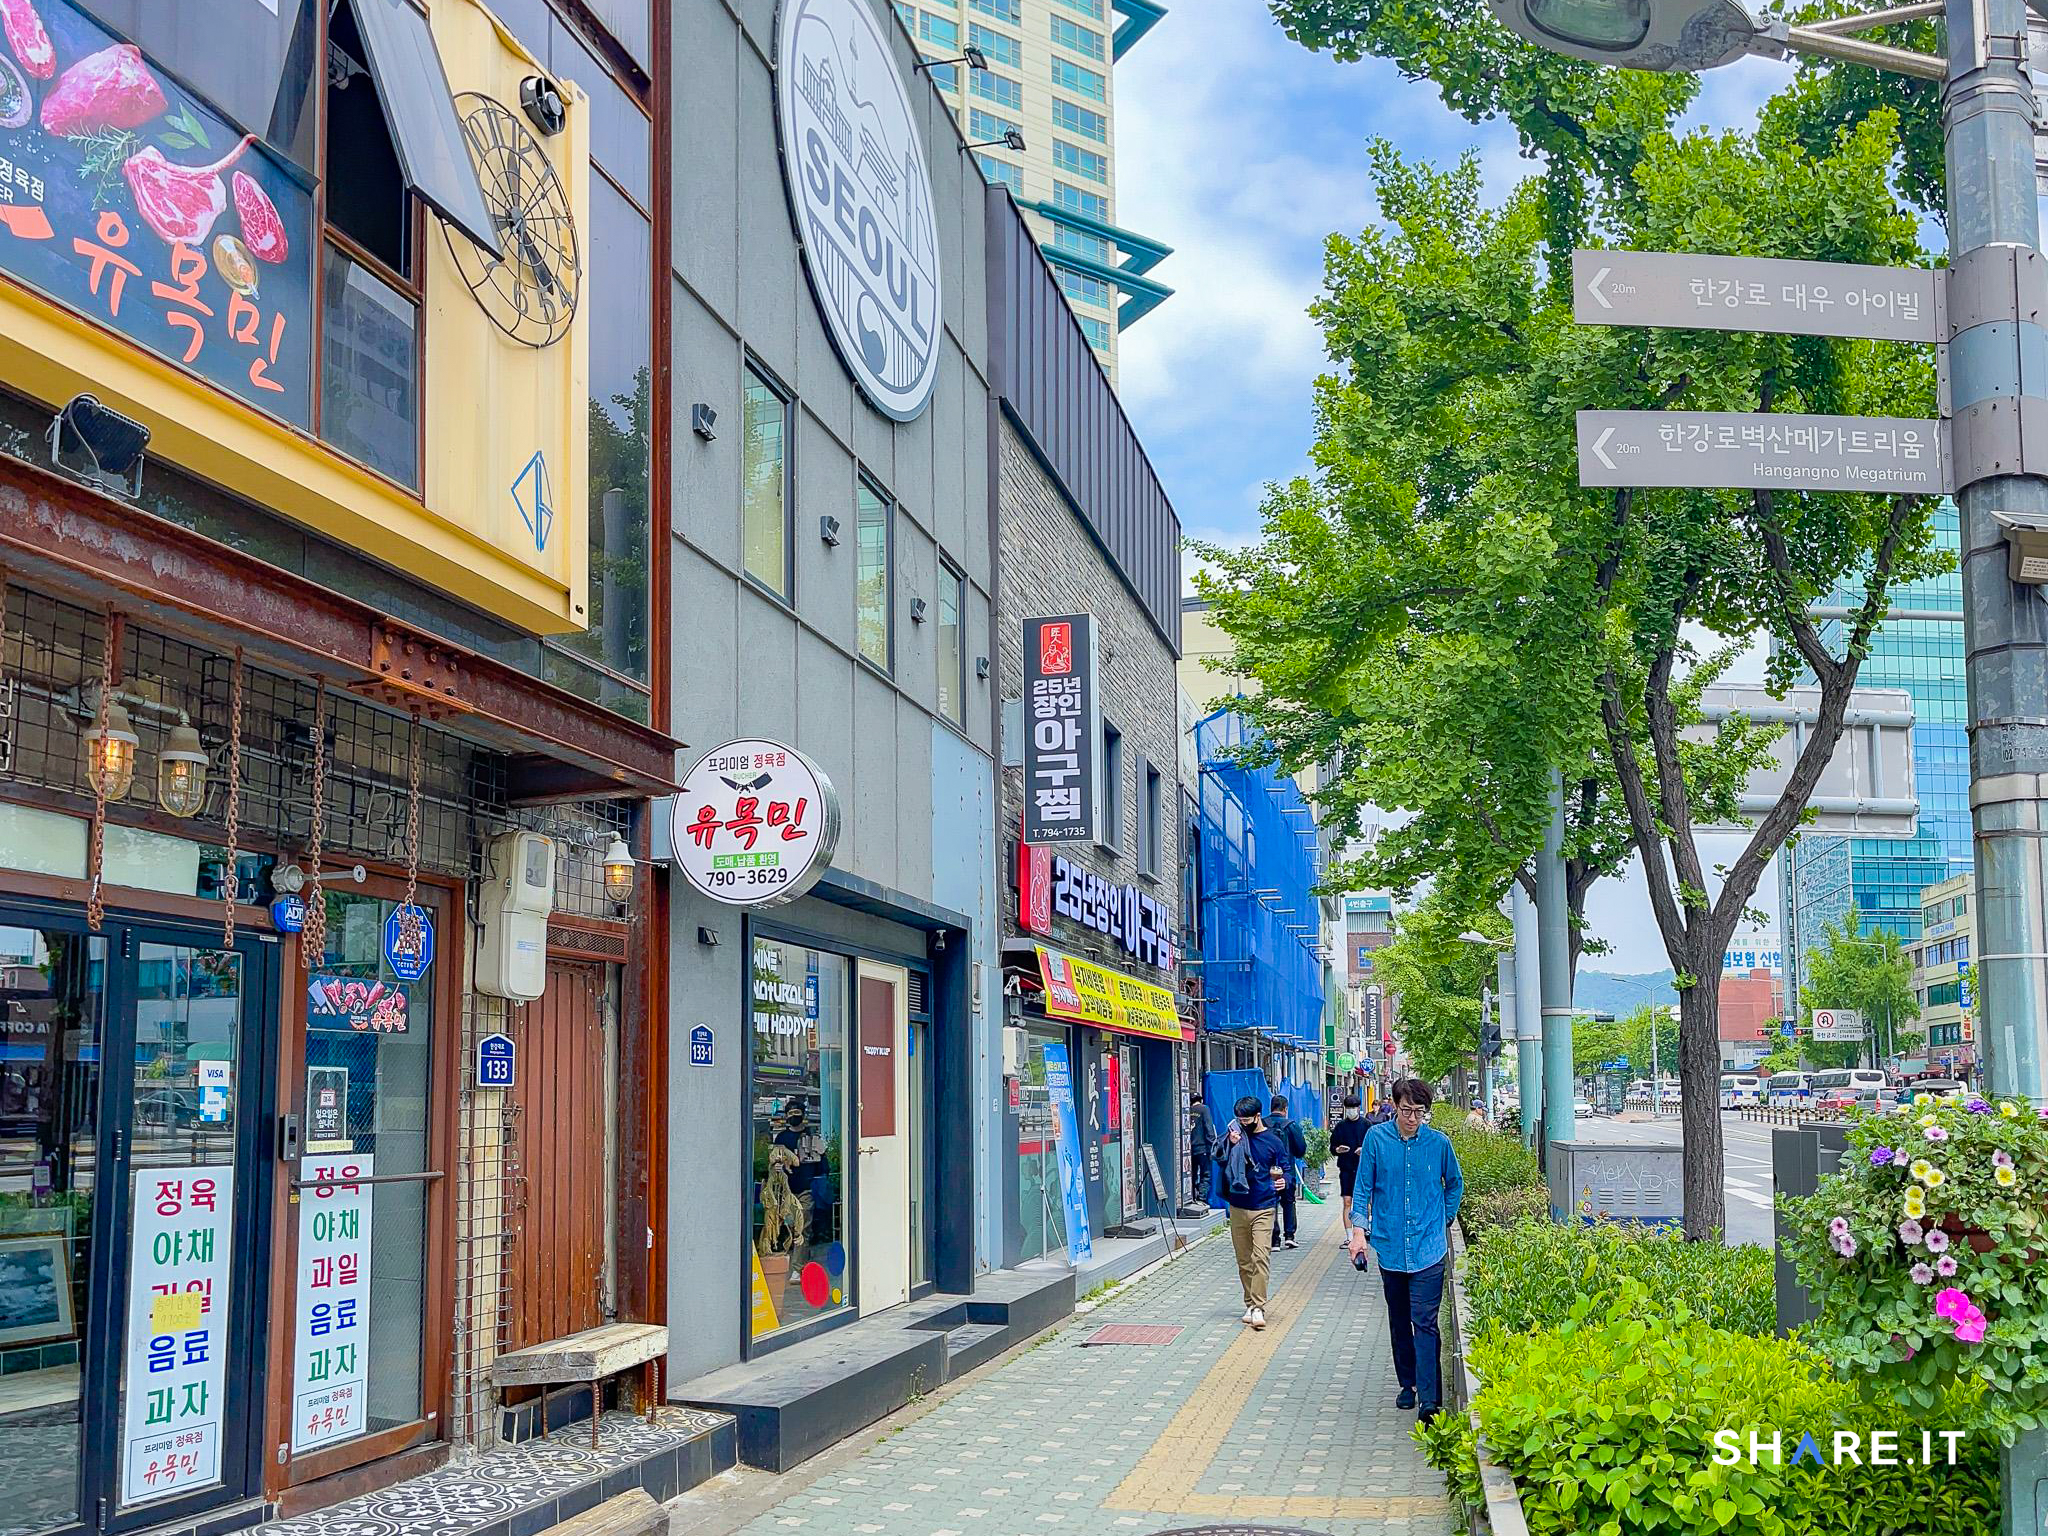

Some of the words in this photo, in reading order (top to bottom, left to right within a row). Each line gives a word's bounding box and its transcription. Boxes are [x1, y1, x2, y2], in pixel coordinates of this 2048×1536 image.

[806, 127, 927, 346] SEOUL
[74, 210, 285, 393] 유목민
[1612, 283, 1636, 294] 20m
[1689, 278, 1771, 308] 한강로
[1782, 284, 1834, 313] 대우
[1845, 288, 1919, 321] 아이빌
[1616, 443, 1640, 455] 20m
[1658, 422, 1924, 459] 한강로벽산메가트리움
[1753, 462, 1840, 480] Hangangno
[1845, 465, 1927, 483] Megatrium
[1033, 676, 1081, 694] 25년
[1033, 693, 1081, 718] 장인
[708, 756, 749, 771] 프리미엄
[754, 752, 786, 768] 정육점
[1034, 718, 1082, 821] 아구찜
[687, 797, 808, 850] 유목민
[1033, 829, 1041, 838] T.
[1042, 827, 1085, 837] 794-1735
[759, 853, 777, 865] 환영
[706, 868, 788, 887] 790-3629
[285, 907, 303, 920] ADT
[371, 1011, 406, 1032] 유목민
[693, 1045, 711, 1060] 133-1
[206, 1069, 224, 1078] VISA
[487, 1060, 508, 1079] 133
[155, 1179, 216, 1216] 정육
[315, 1166, 360, 1198] 정육
[313, 1209, 359, 1242] 야채
[153, 1228, 214, 1266] 야채
[311, 1253, 358, 1288] 과일
[310, 1299, 356, 1336] 음료
[148, 1330, 209, 1373] 음료
[308, 1343, 357, 1382] 과자
[145, 1380, 208, 1425] 과자
[308, 1395, 329, 1407] 프리미엄
[332, 1387, 352, 1401] 정육점
[308, 1405, 349, 1435] 유목민
[144, 1440, 173, 1453] 프리미엄
[175, 1431, 203, 1448] 정육점
[144, 1451, 198, 1485] 유목민
